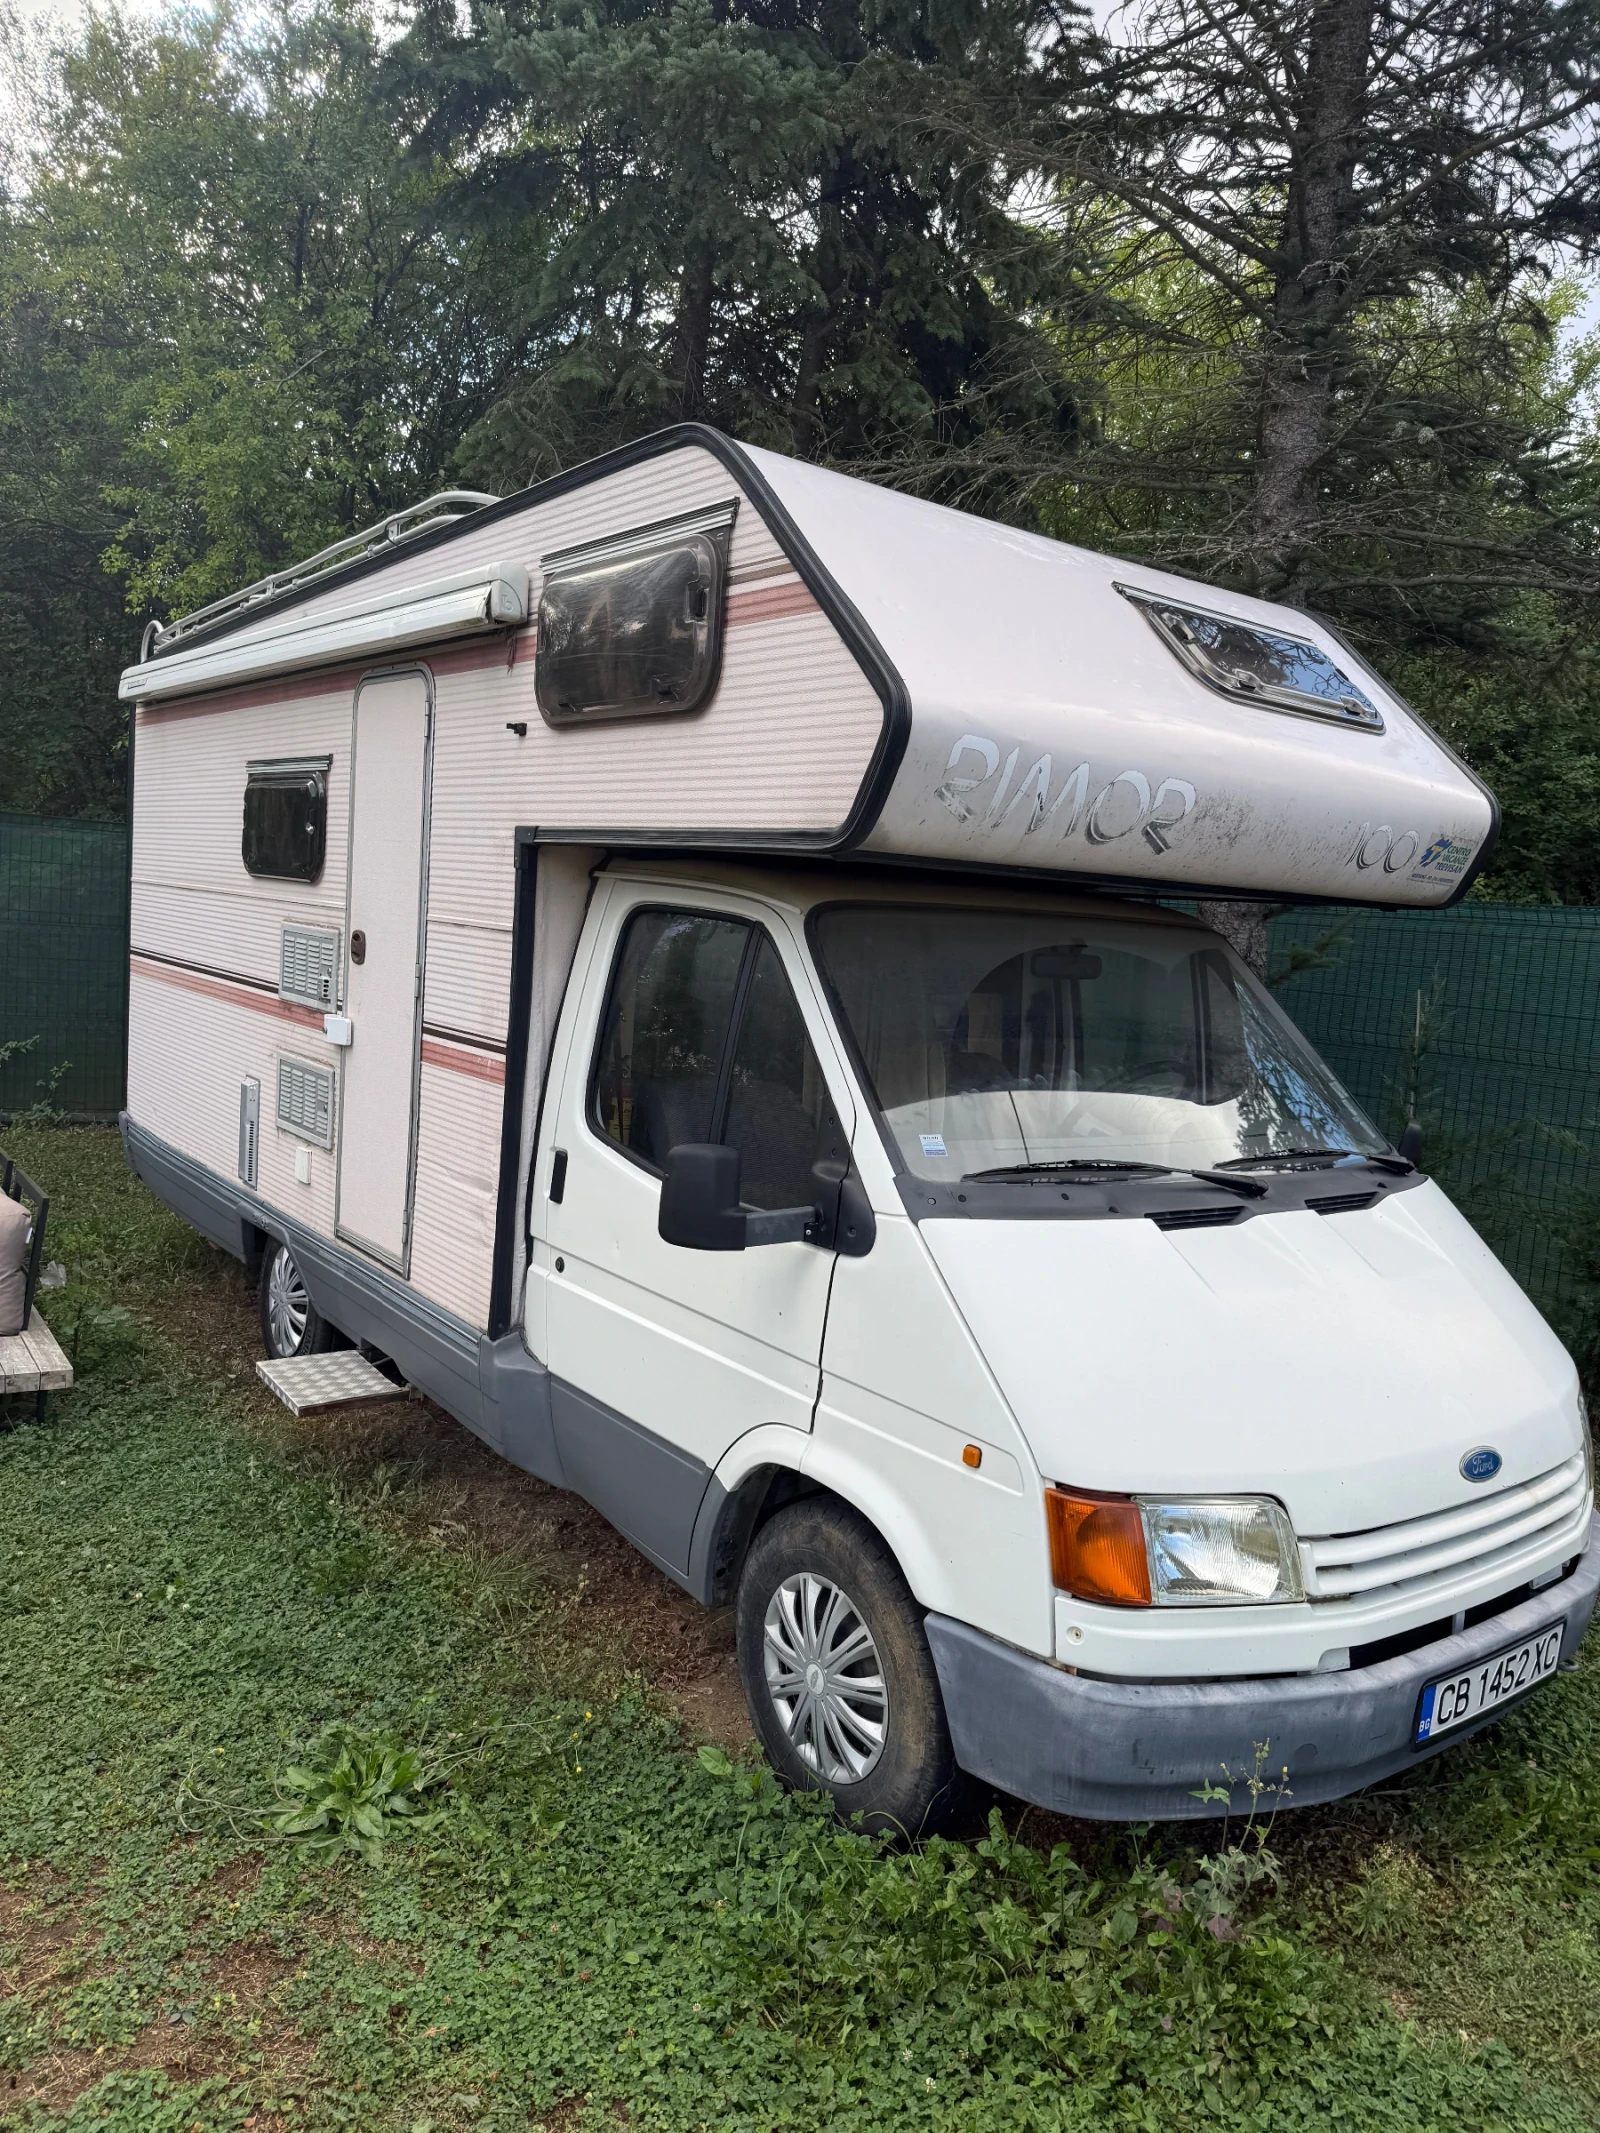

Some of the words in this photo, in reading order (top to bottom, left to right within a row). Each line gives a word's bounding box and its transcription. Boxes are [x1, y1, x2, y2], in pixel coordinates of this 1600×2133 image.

[933, 734, 1198, 855] RIMOR
[1344, 820, 1420, 874] 100
[1446, 845, 1472, 857] CENTRO
[1434, 861, 1465, 874] TREVISAN
[1472, 1454, 1494, 1475] Ford
[1436, 1677, 1471, 1725] CB
[1479, 1648, 1530, 1707] 1452
[1529, 1631, 1558, 1681] XC
[1418, 1717, 1431, 1734] BG
